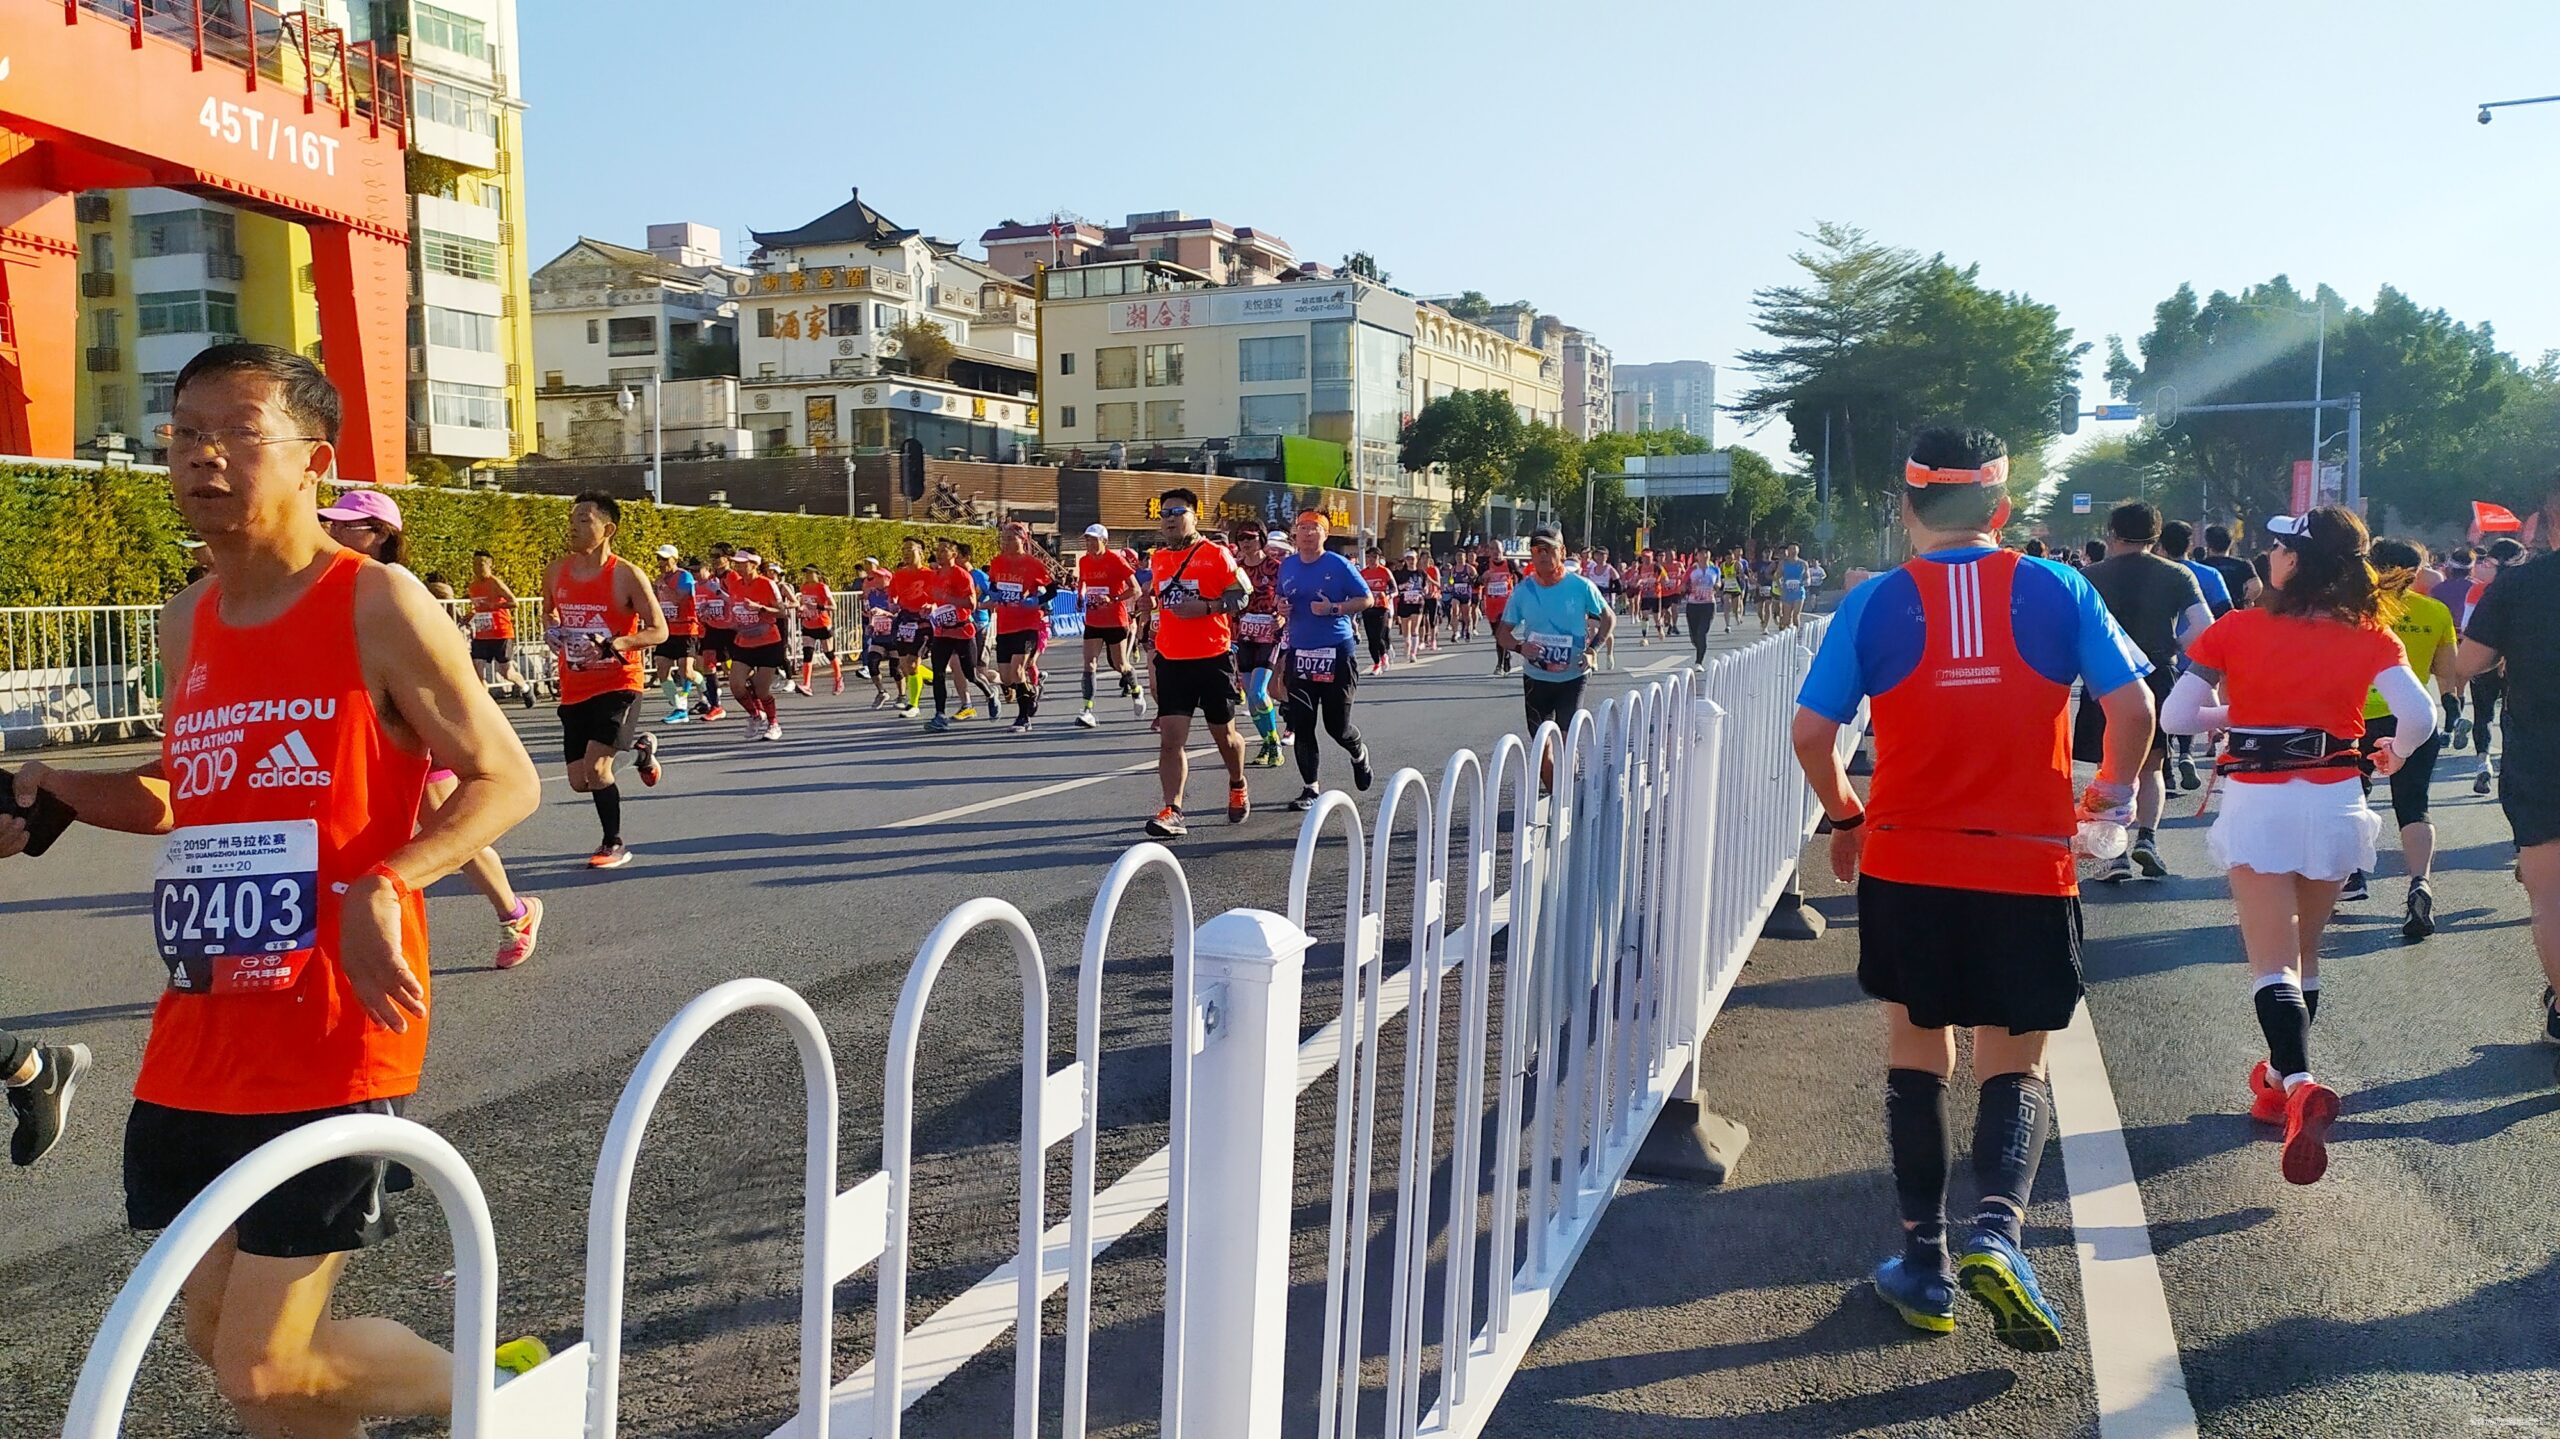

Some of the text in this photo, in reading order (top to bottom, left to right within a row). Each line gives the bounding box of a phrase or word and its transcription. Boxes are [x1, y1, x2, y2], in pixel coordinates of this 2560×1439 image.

[199, 96, 340, 177] 45T/16T
[774, 304, 829, 342] 酒家
[1241, 622, 1272, 635] D9972
[1296, 657, 1333, 671] D0747
[174, 698, 336, 736] GUANGZHOU
[171, 729, 244, 755] MARATHON
[173, 747, 238, 800] 2019
[248, 767, 331, 789] adidas
[238, 847, 287, 856] MARATHON
[161, 878, 303, 941] C2403
